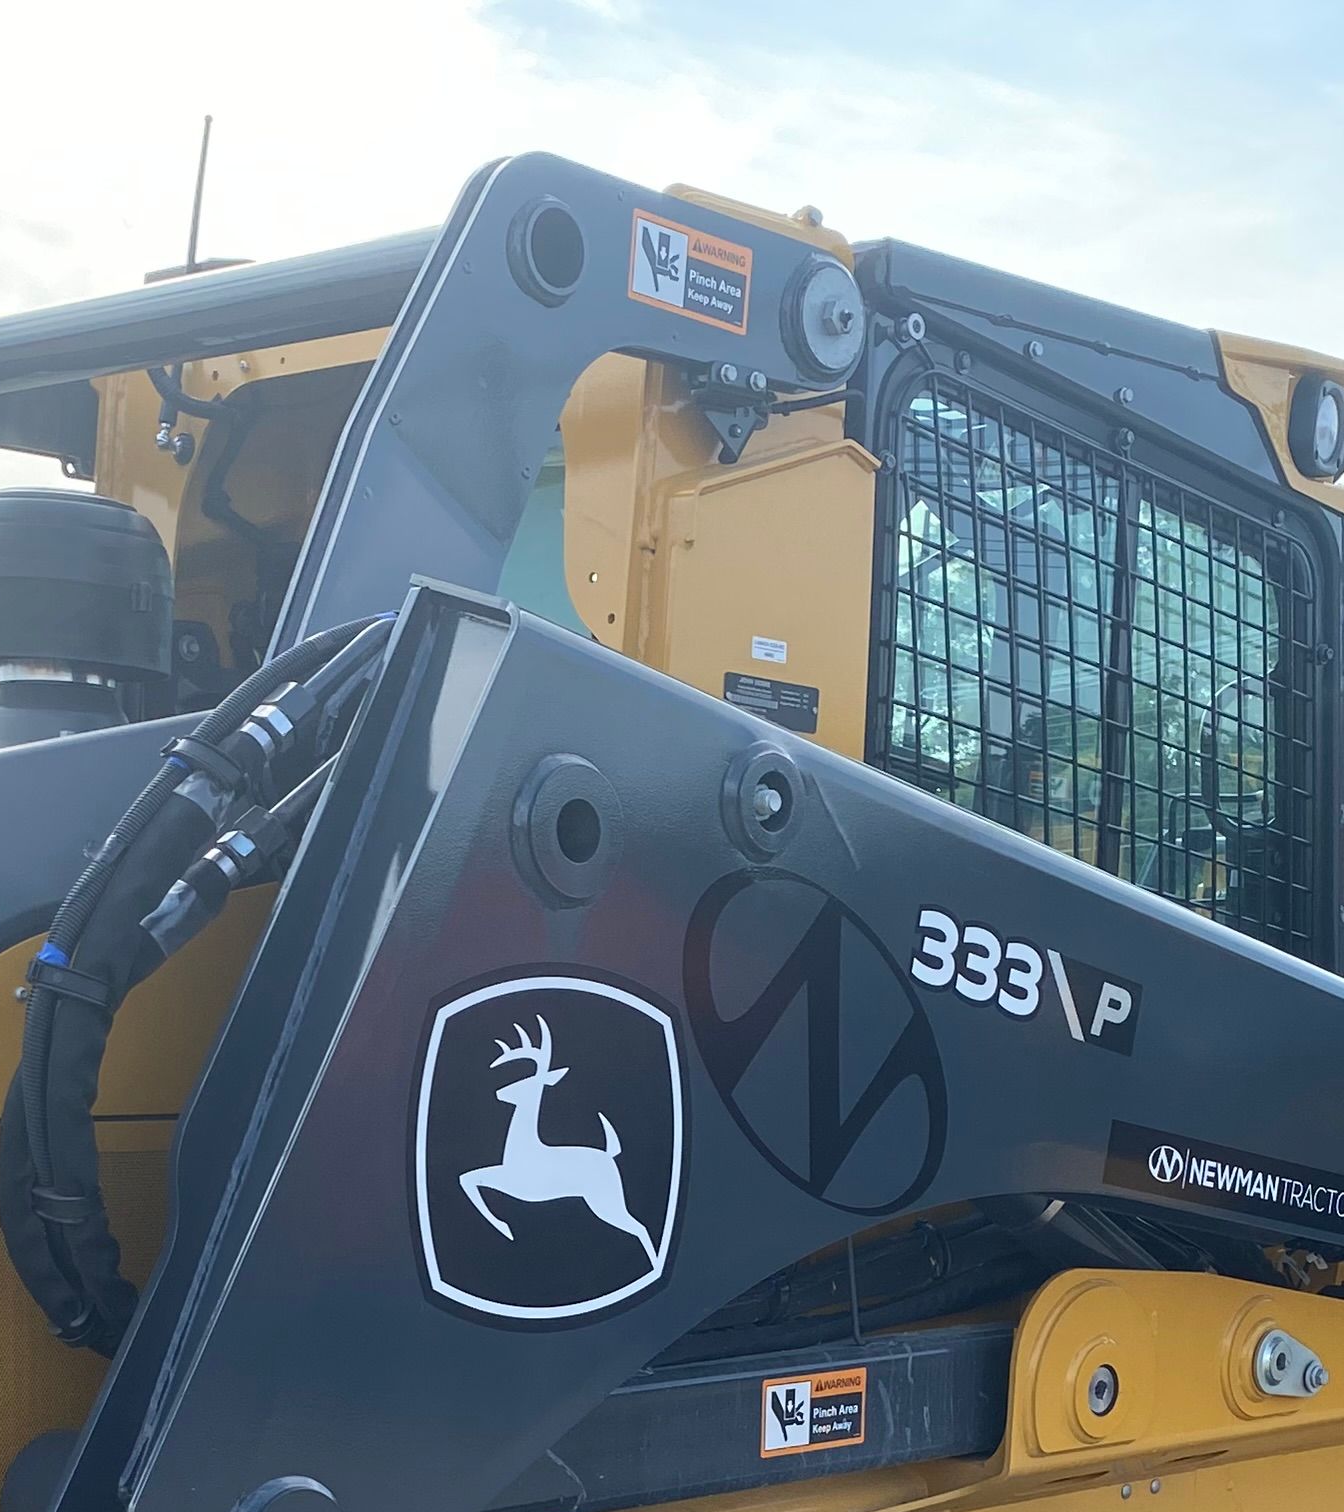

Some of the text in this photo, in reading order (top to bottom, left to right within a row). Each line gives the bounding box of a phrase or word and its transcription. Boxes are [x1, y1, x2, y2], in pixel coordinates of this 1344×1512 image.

[702, 244, 746, 267] WARNING
[689, 269, 742, 298] Pinch Area
[687, 288, 733, 314] Keep Away
[823, 1376, 861, 1390] WARNING
[813, 1404, 859, 1419] Pinch Area
[812, 1421, 852, 1435] Keep Away
